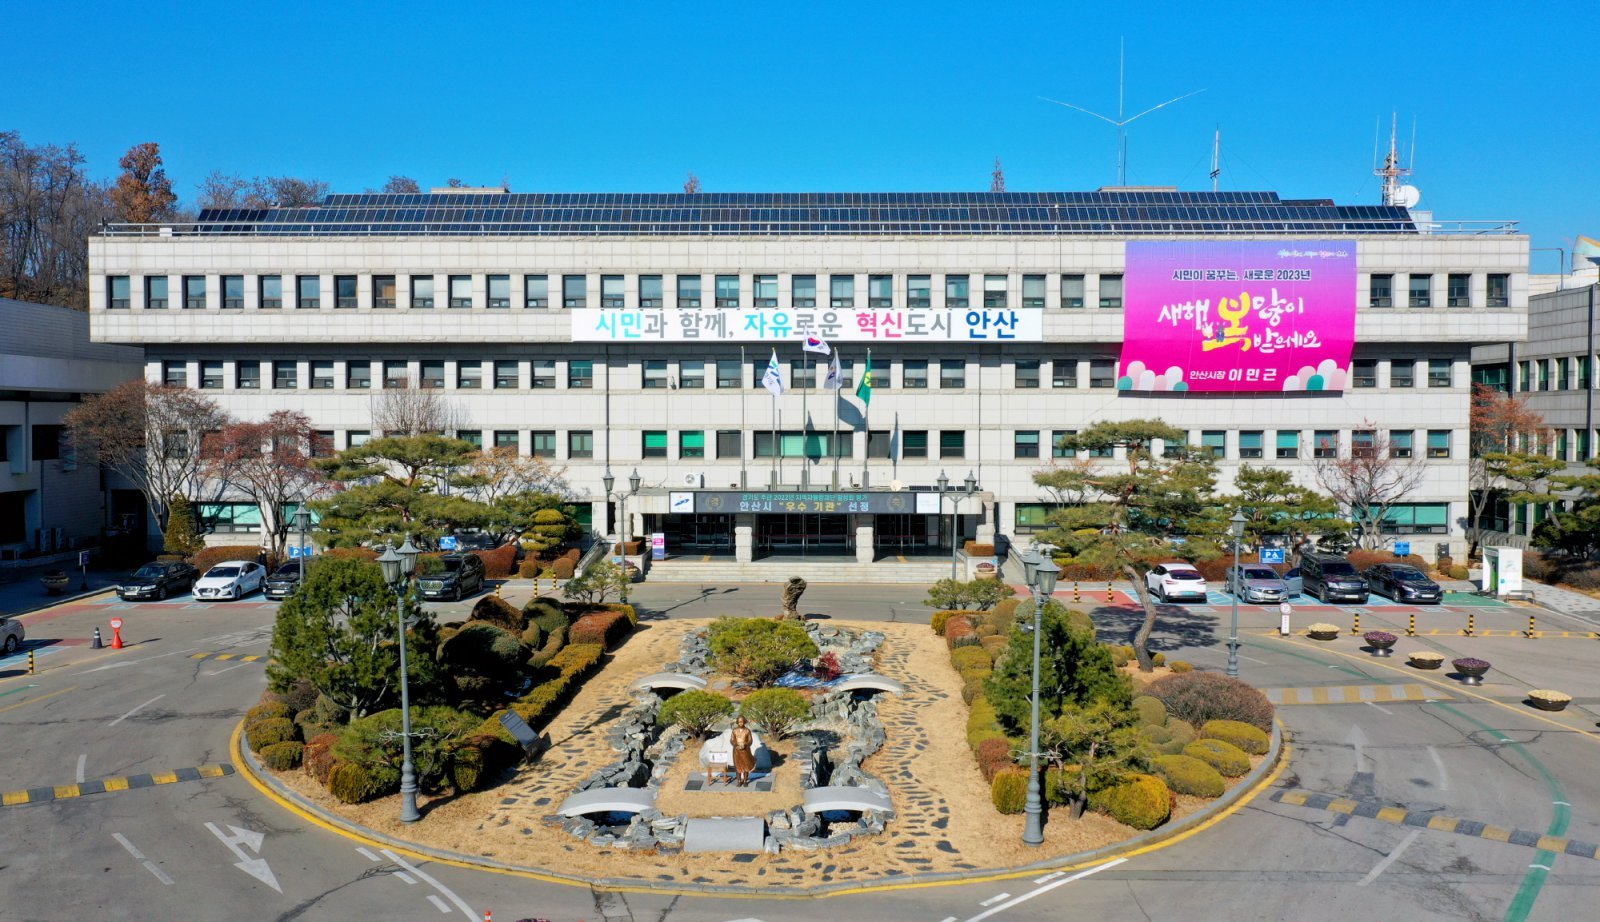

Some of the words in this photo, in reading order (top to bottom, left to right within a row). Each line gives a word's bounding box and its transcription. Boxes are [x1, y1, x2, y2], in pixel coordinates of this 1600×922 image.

[1172, 269, 1204, 281] 시민이
[1243, 269, 1275, 281] 새로운
[1276, 269, 1311, 281] 2023년
[595, 312, 668, 338] 시민과
[680, 312, 734, 338] 함께,
[744, 312, 843, 338] 자유로운
[856, 312, 951, 338] 혁신도시
[965, 311, 1019, 339] 안산
[1157, 298, 1210, 330] 새해
[1202, 291, 1252, 352] 복
[1252, 288, 1304, 326] 많이
[1253, 328, 1321, 354] 받으세요
[1189, 370, 1226, 381] 안산시장
[740, 501, 772, 512] 안산시
[848, 501, 869, 512] 선정
